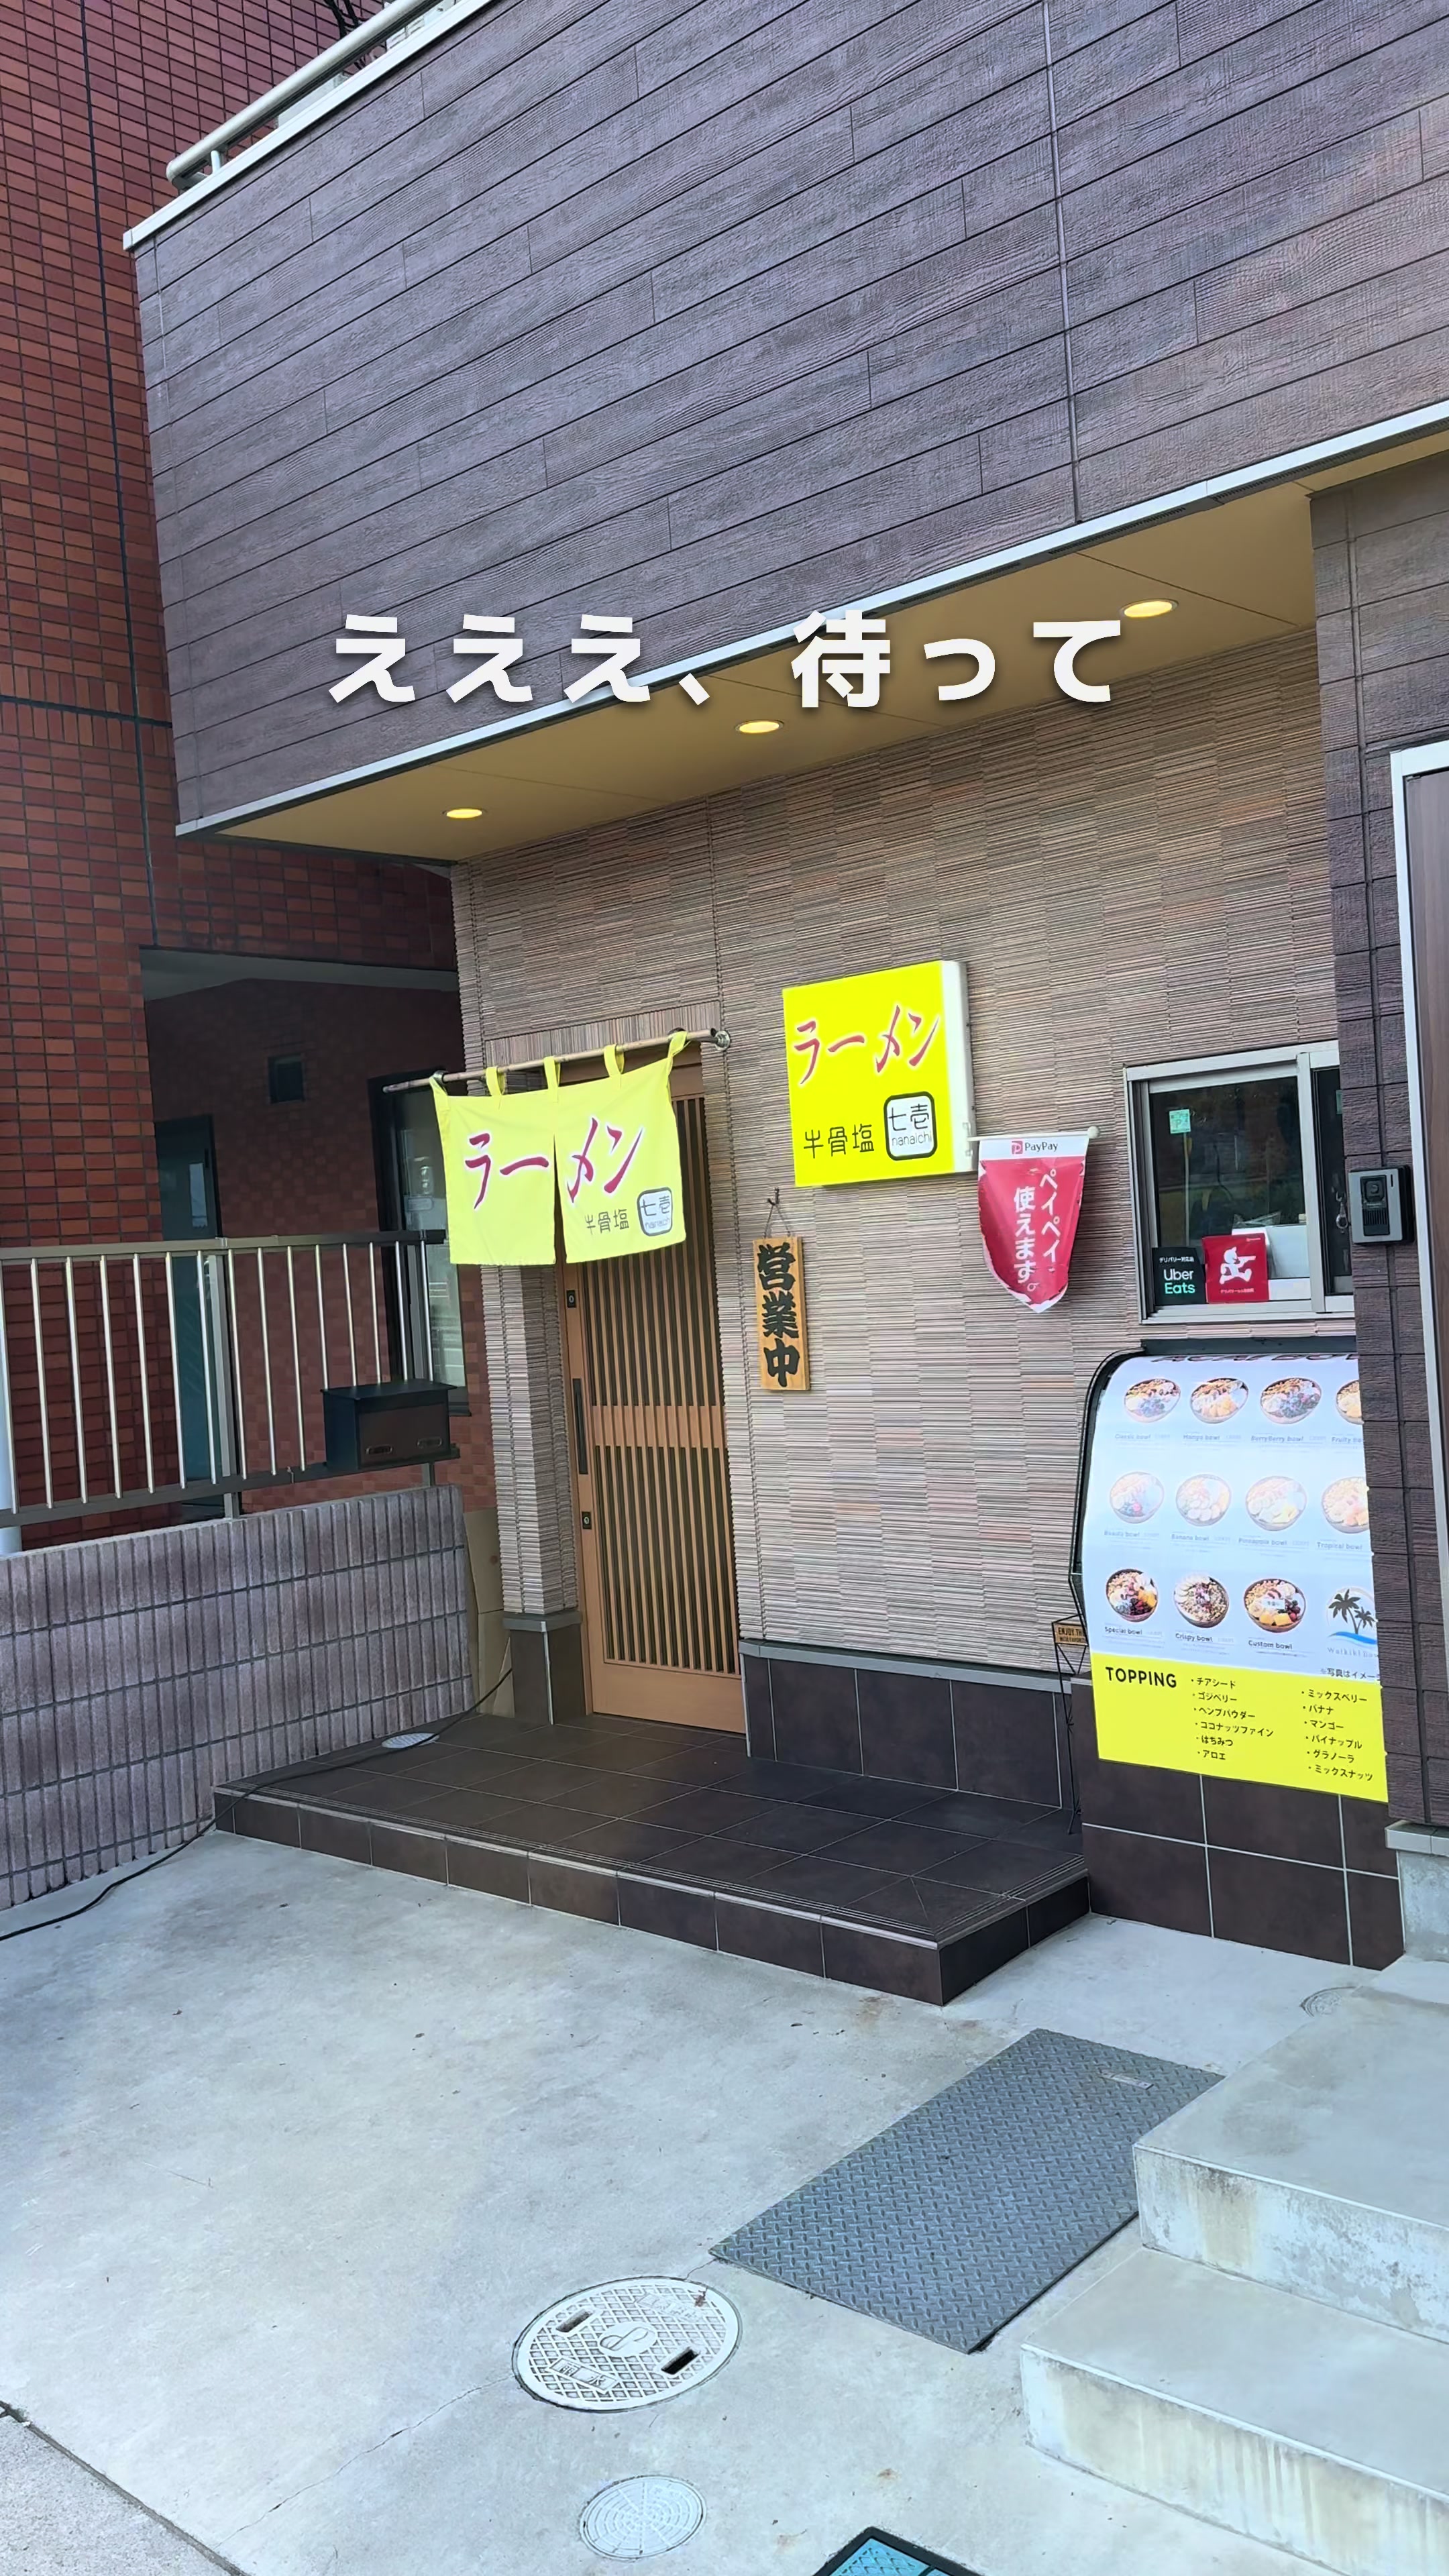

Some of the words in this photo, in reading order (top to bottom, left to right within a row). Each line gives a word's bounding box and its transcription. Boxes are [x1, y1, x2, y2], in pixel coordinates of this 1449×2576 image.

[794, 1004, 940, 1085] ラーメン
[892, 1131, 932, 1146] nanaichi
[1024, 1142, 1059, 1152] PayPay
[464, 1117, 643, 1210] ラーメン
[1040, 1169, 1061, 1263] ペイペイ
[1014, 1185, 1039, 1293] 使えます。
[1163, 1269, 1194, 1281] Uber
[1165, 1283, 1195, 1295] Eats
[757, 1242, 800, 1388] 営業中
[1317, 1541, 1344, 1550] Tropical
[1175, 1632, 1195, 1642] Crispy
[1248, 1640, 1274, 1648] Custom
[1106, 1666, 1177, 1688] TOPPING
